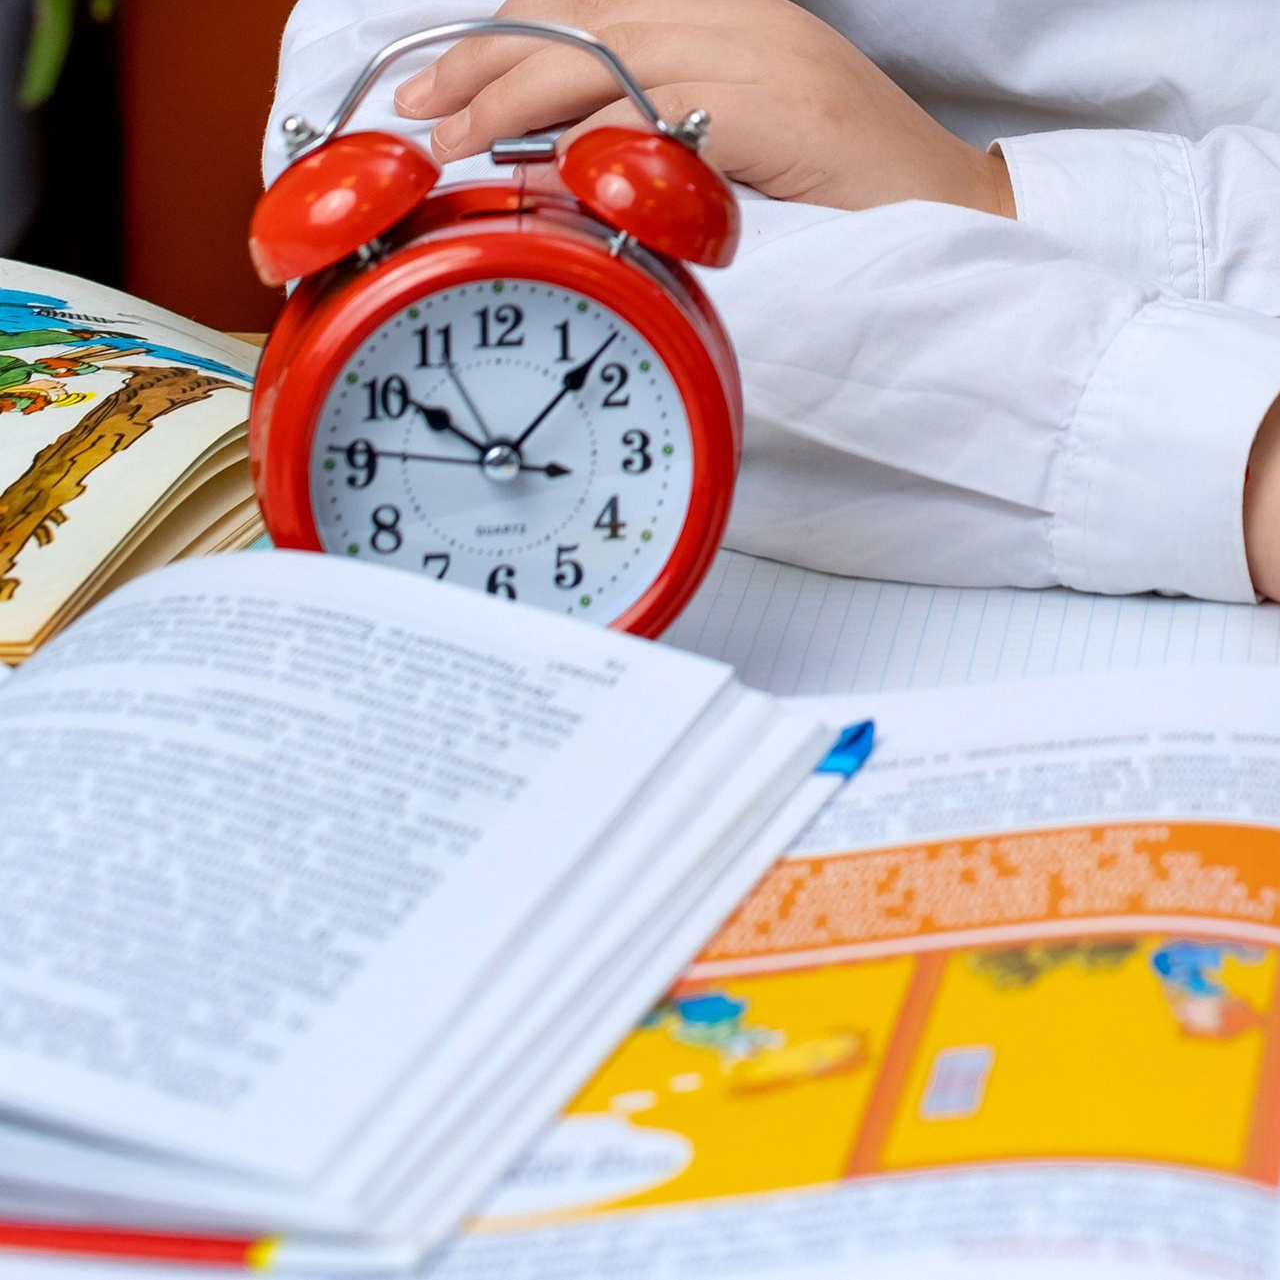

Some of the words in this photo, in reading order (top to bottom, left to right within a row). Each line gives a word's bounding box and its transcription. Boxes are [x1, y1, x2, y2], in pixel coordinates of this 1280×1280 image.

[414, 325, 455, 367] 11
[474, 303, 525, 348] 12
[554, 320, 576, 362] 1
[364, 375, 409, 421] 10
[601, 363, 629, 407] 2
[345, 440, 378, 488] 9
[622, 430, 652, 473] 3
[370, 505, 401, 553] 8
[594, 496, 626, 539] 4
[486, 565, 517, 600] 6
[555, 546, 583, 588] 5
